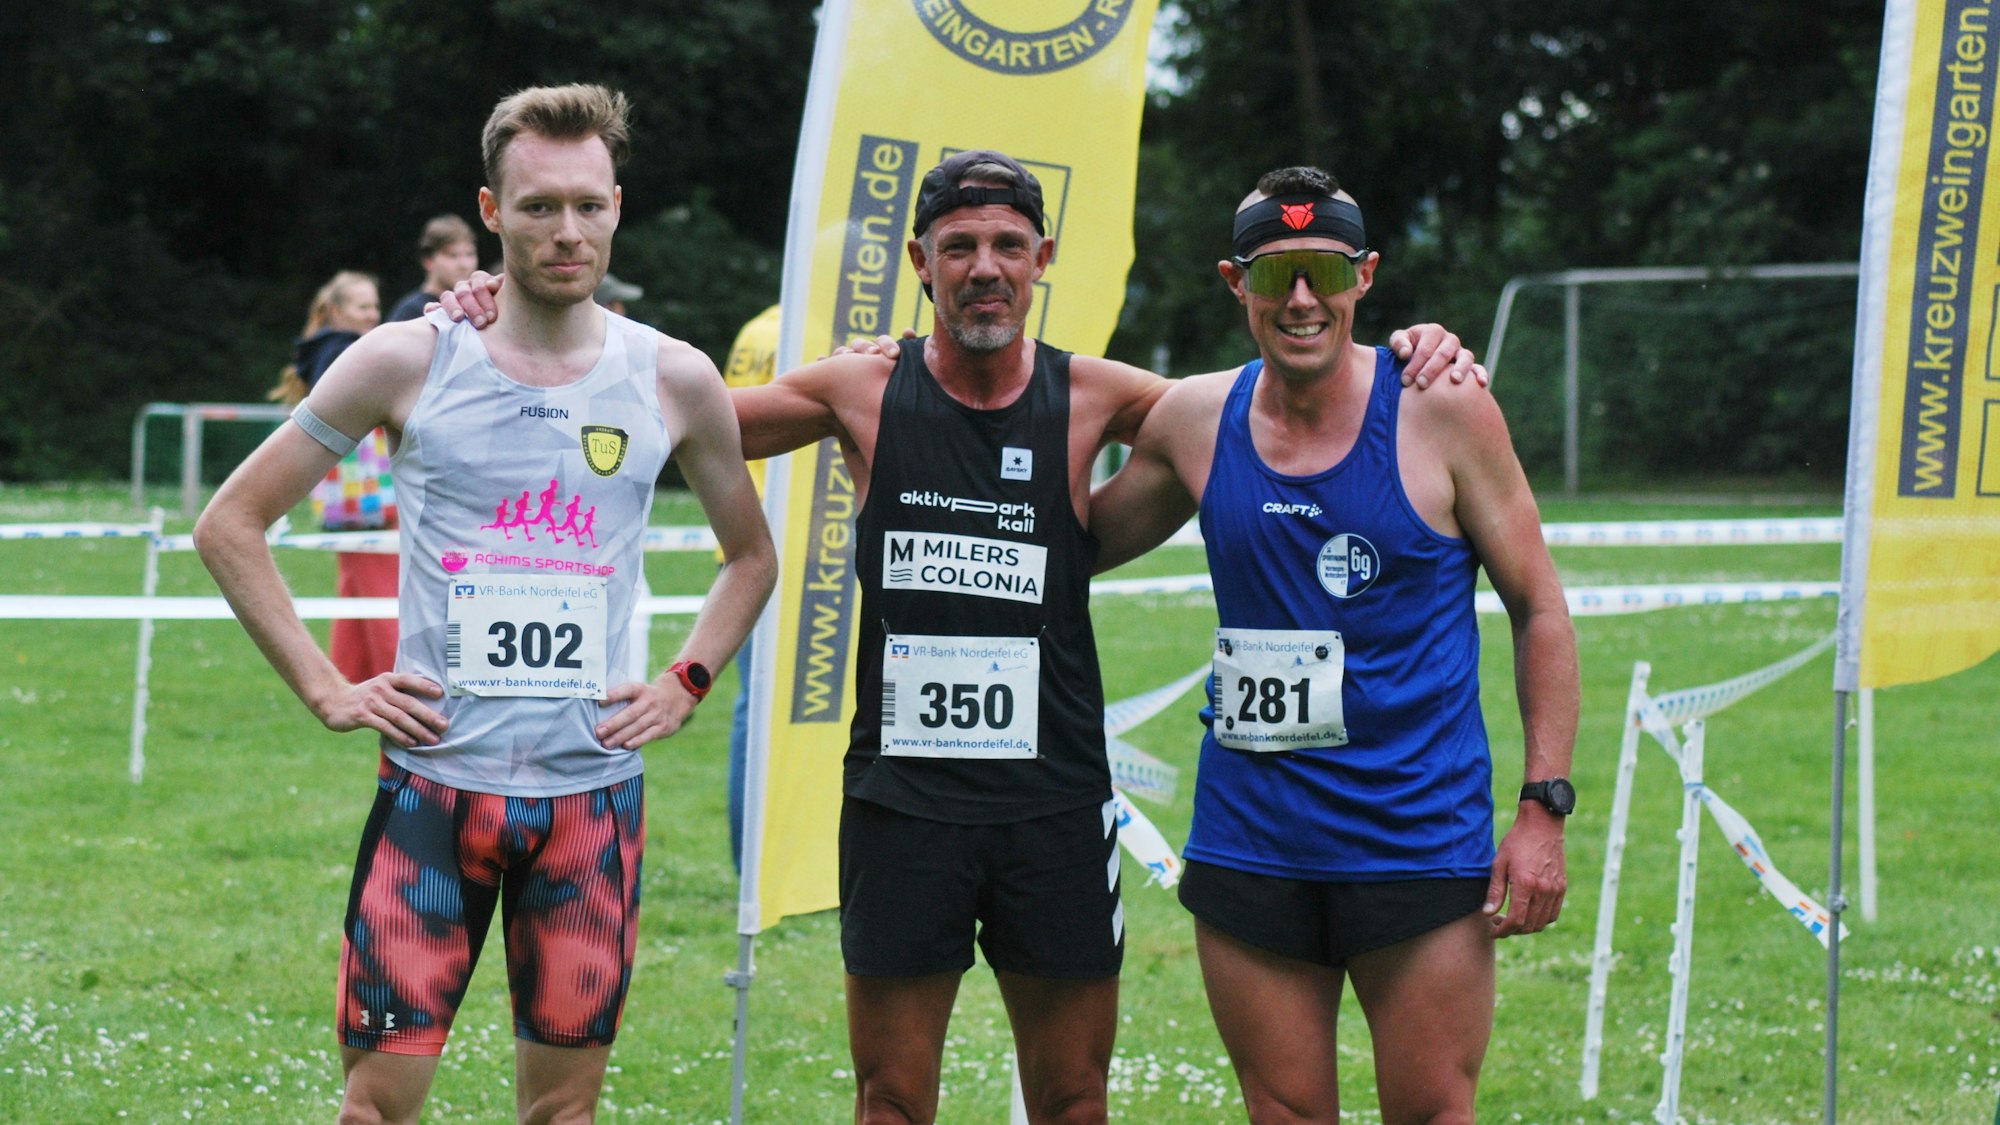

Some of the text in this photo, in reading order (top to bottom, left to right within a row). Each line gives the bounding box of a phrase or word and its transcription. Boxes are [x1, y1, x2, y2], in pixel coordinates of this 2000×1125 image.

[520, 406, 569, 420] FUSION
[592, 438, 617, 455] TuS
[1263, 502, 1310, 515] CRAFT
[997, 515, 1034, 533] kall
[923, 539, 1019, 566] MILERS
[475, 553, 531, 567] ACHIMS
[535, 558, 615, 576] SPORTSHOP
[1351, 546, 1371, 580] 69
[921, 565, 1038, 596] COLONIA
[479, 586, 598, 599] VR-Bank Nordeifel eG
[487, 621, 583, 669] 302
[913, 647, 1028, 659] VR-Bank Nordeifel eG
[1265, 642, 1314, 652] Nordeifel
[458, 677, 597, 690] www.vr-banknordeifel.de
[919, 682, 1014, 730] 350
[1238, 676, 1310, 724] 281
[892, 738, 1029, 749] www.vr-banknordeifel.de
